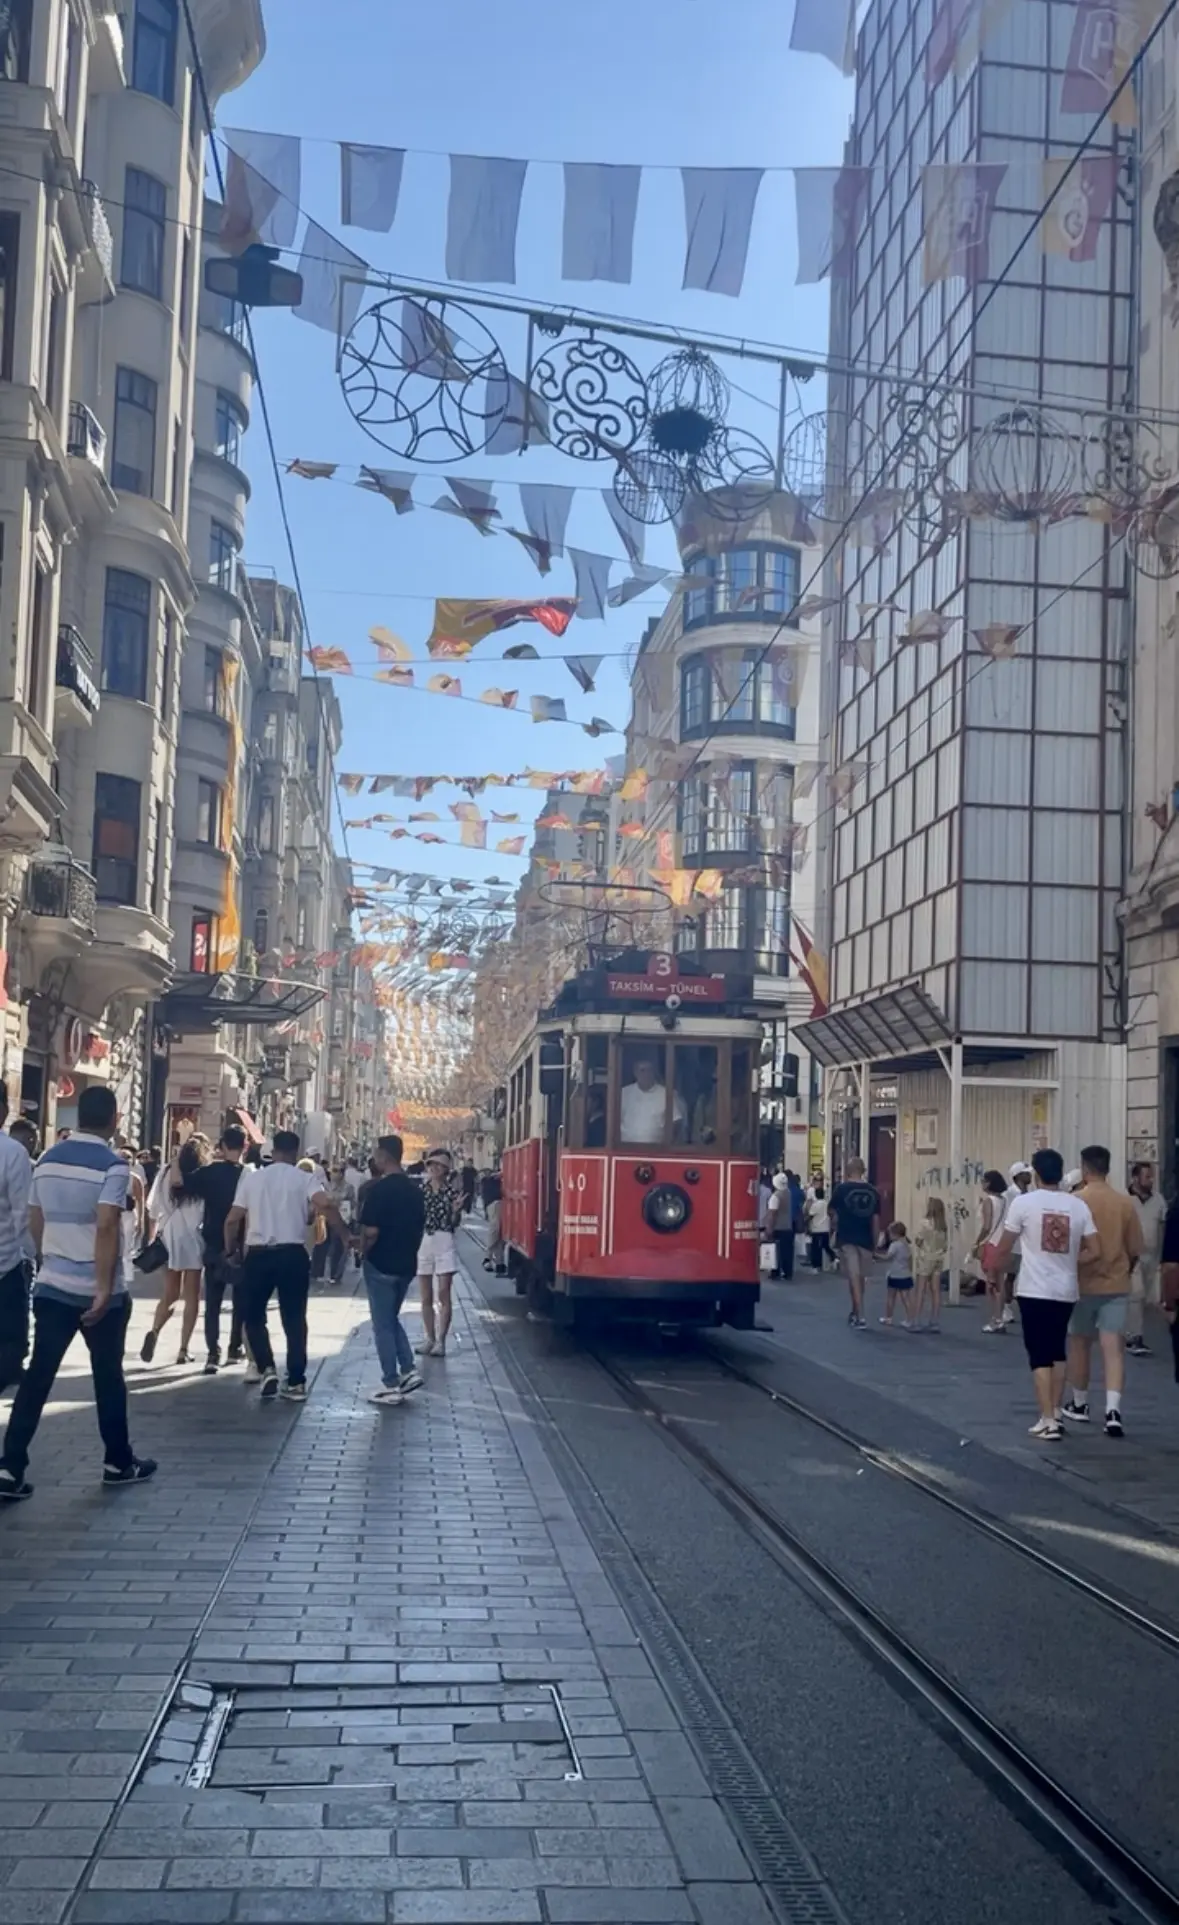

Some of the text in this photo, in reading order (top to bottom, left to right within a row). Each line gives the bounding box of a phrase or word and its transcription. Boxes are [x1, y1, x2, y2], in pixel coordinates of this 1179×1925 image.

[656, 954, 672, 976] 3
[609, 980, 654, 992] TAKSİM
[669, 982, 708, 995] TÜNEL
